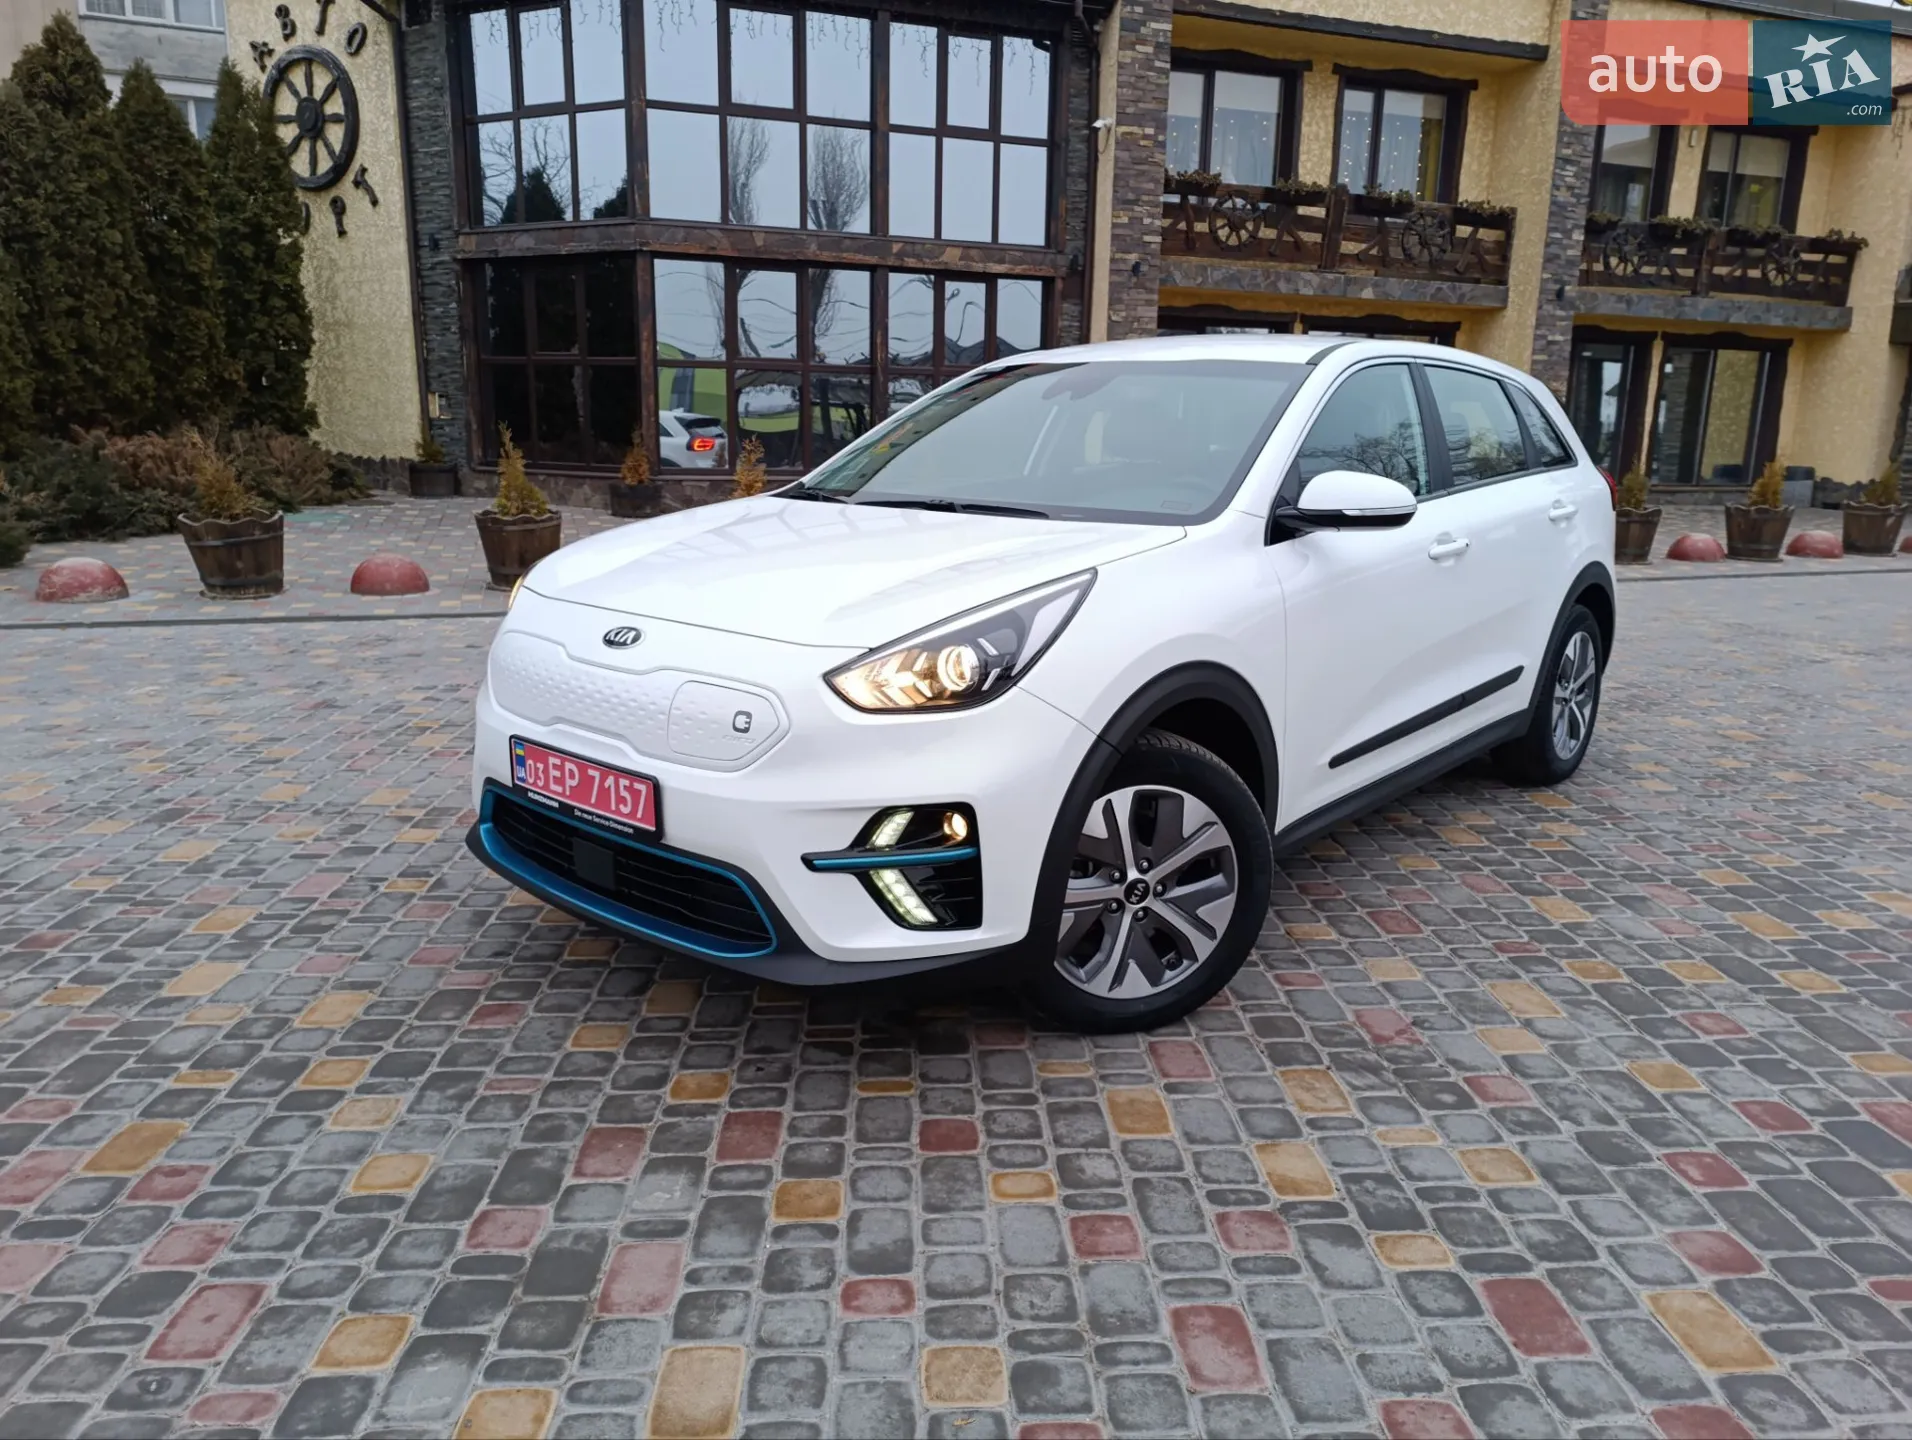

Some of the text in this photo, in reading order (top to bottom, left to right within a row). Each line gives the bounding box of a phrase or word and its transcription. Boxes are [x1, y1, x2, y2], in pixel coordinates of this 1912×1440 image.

[605, 628, 636, 645] KIA
[516, 765, 526, 779] UA
[526, 756, 647, 819] 03 EP 7157
[1129, 883, 1146, 904] KIA
